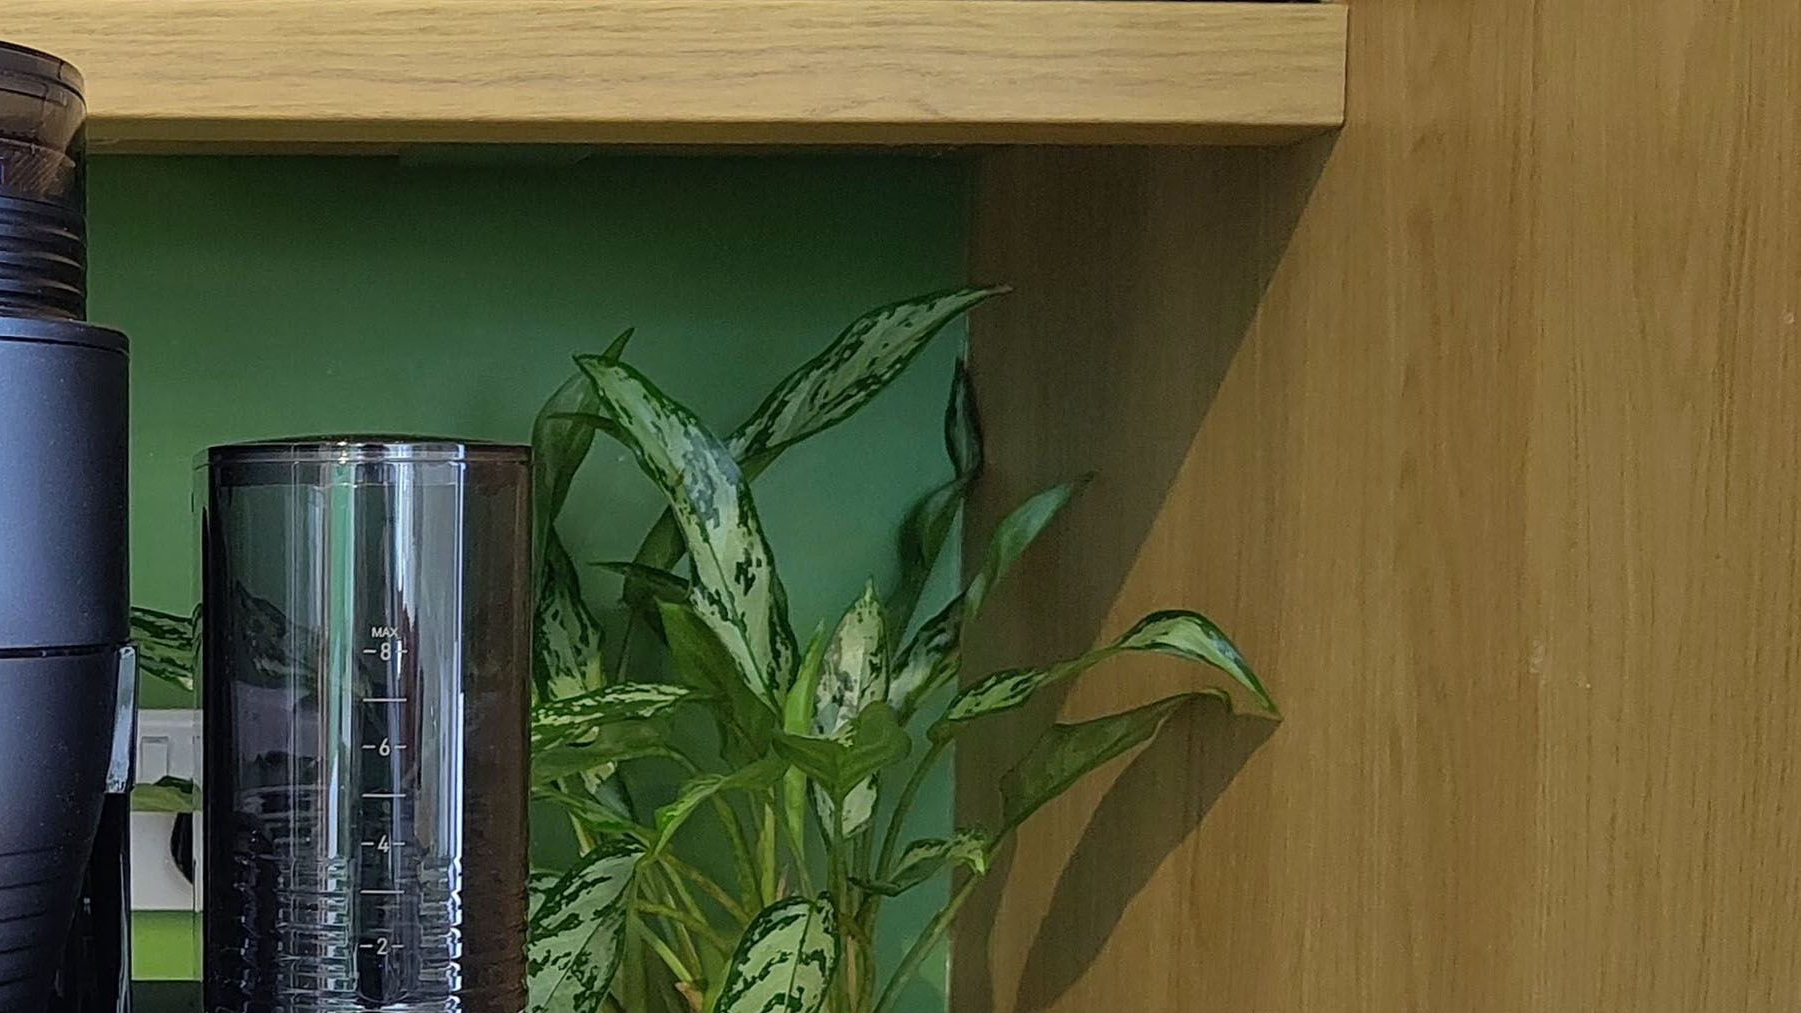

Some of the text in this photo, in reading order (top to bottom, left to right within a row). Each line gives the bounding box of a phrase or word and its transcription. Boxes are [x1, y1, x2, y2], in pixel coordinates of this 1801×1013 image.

[371, 626, 399, 638] MAX
[380, 642, 391, 661] 8
[379, 737, 391, 756] 6
[377, 835, 390, 853] 4
[377, 937, 388, 955] 2
